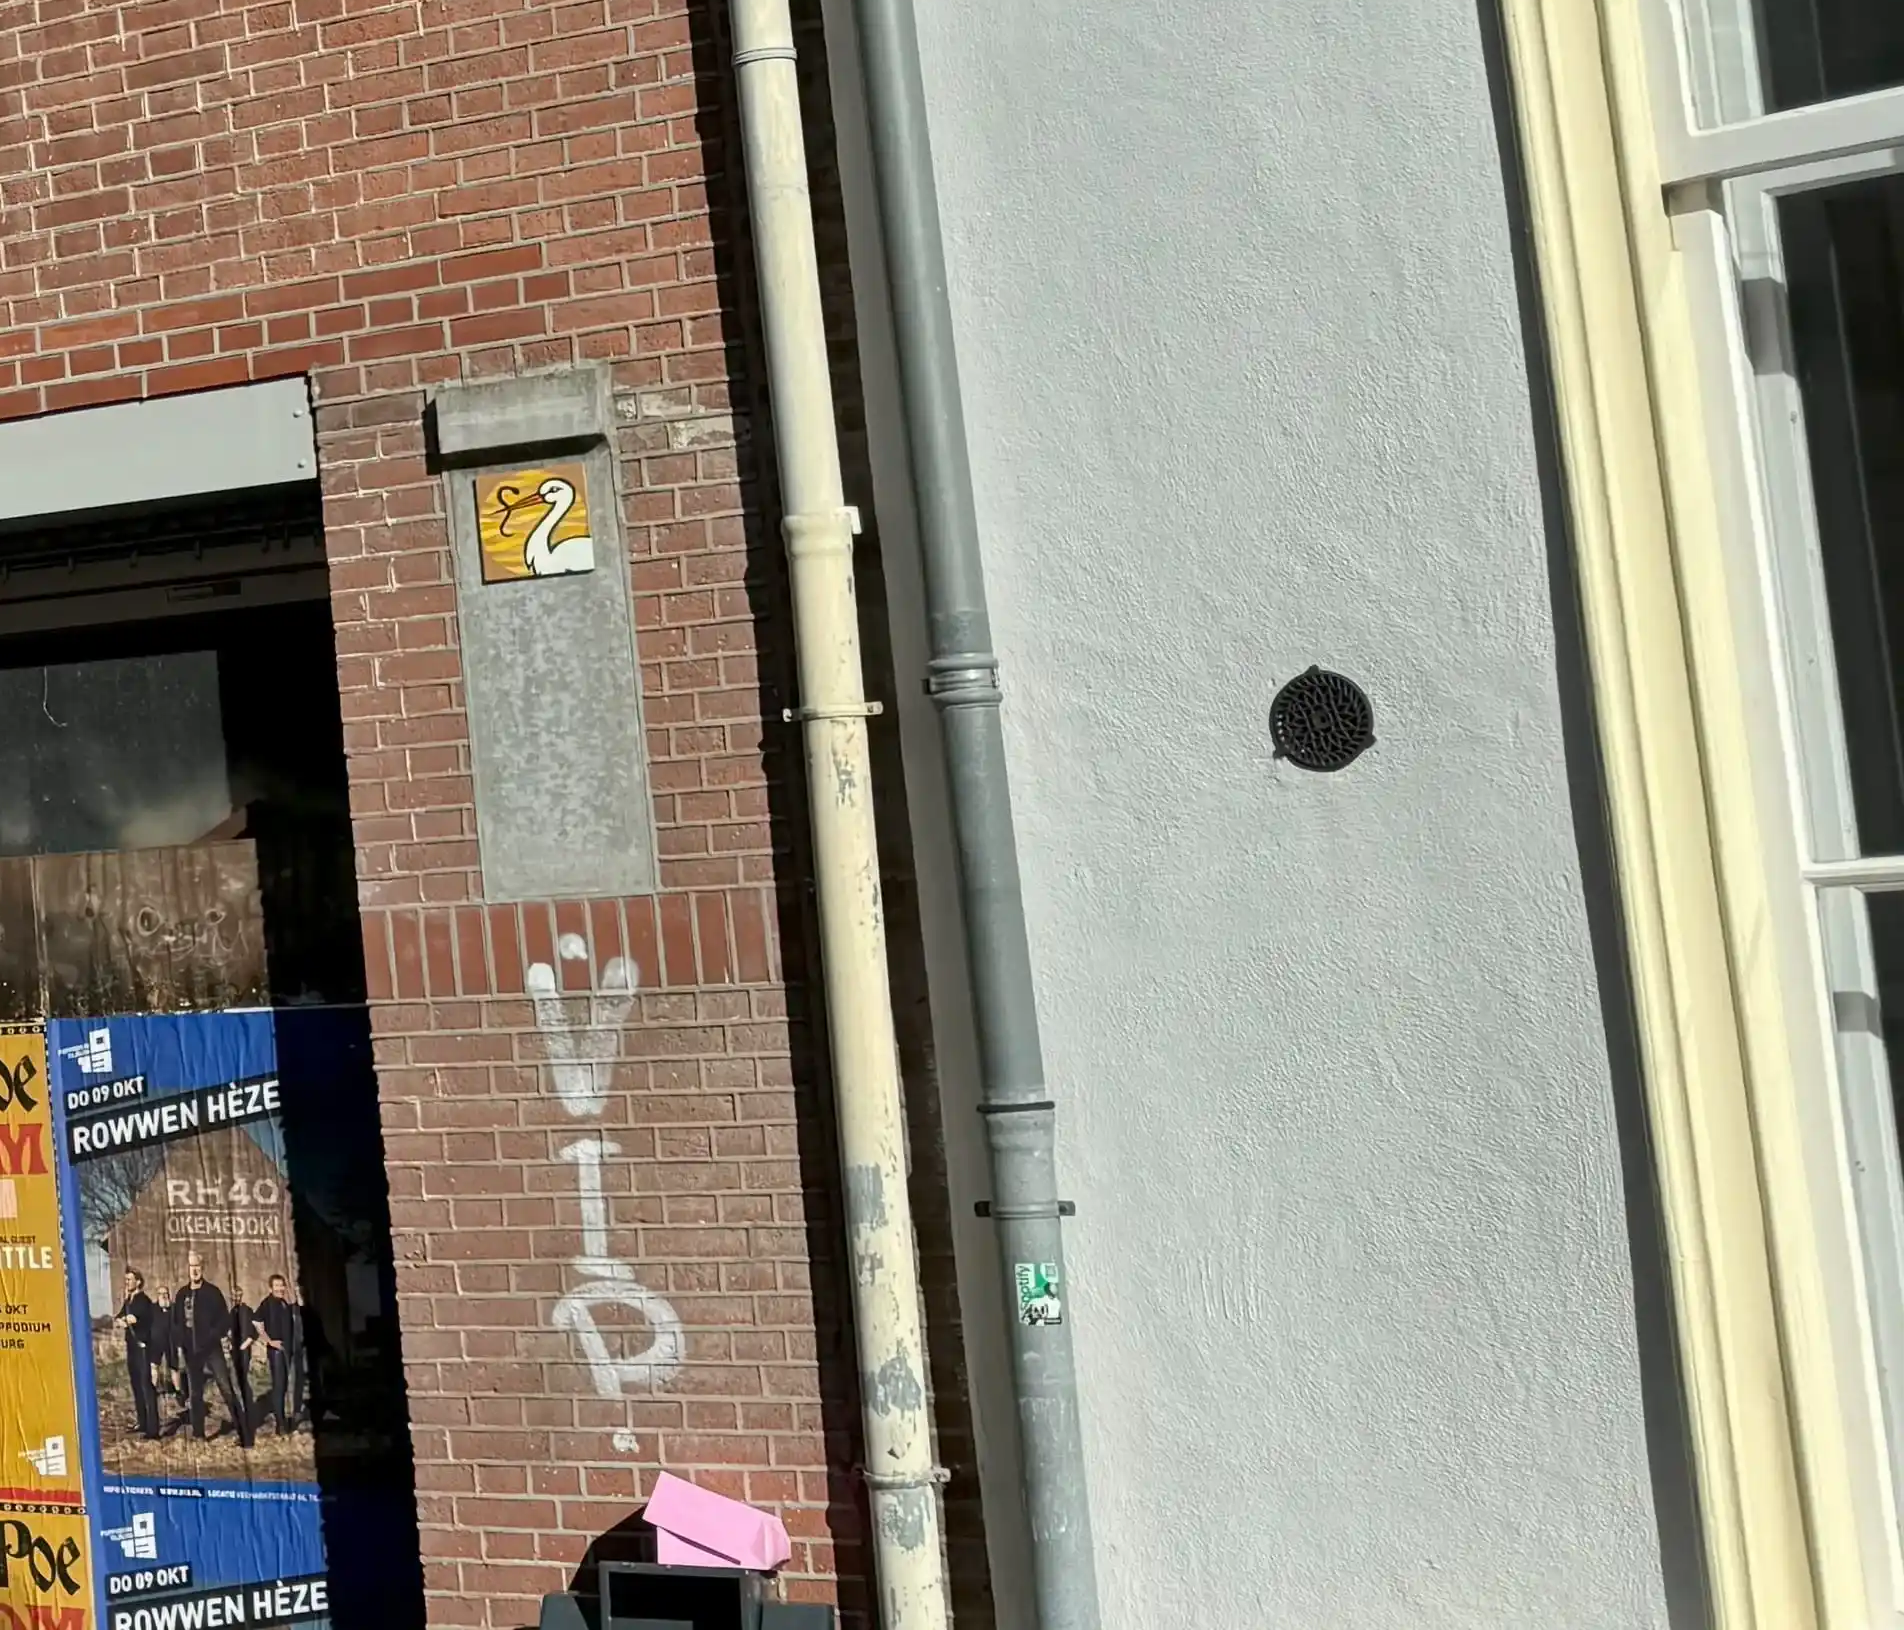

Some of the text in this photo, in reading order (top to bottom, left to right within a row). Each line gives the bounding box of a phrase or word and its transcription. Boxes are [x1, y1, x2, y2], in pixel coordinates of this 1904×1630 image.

[68, 1076, 144, 1110] DO 09 OKT
[73, 1079, 281, 1155] ROWWEN HÈZE
[5, 1304, 28, 1315] OKT
[110, 1565, 189, 1594] DO 09 OKT
[114, 1579, 329, 1630] ROWWEN HÈZE
